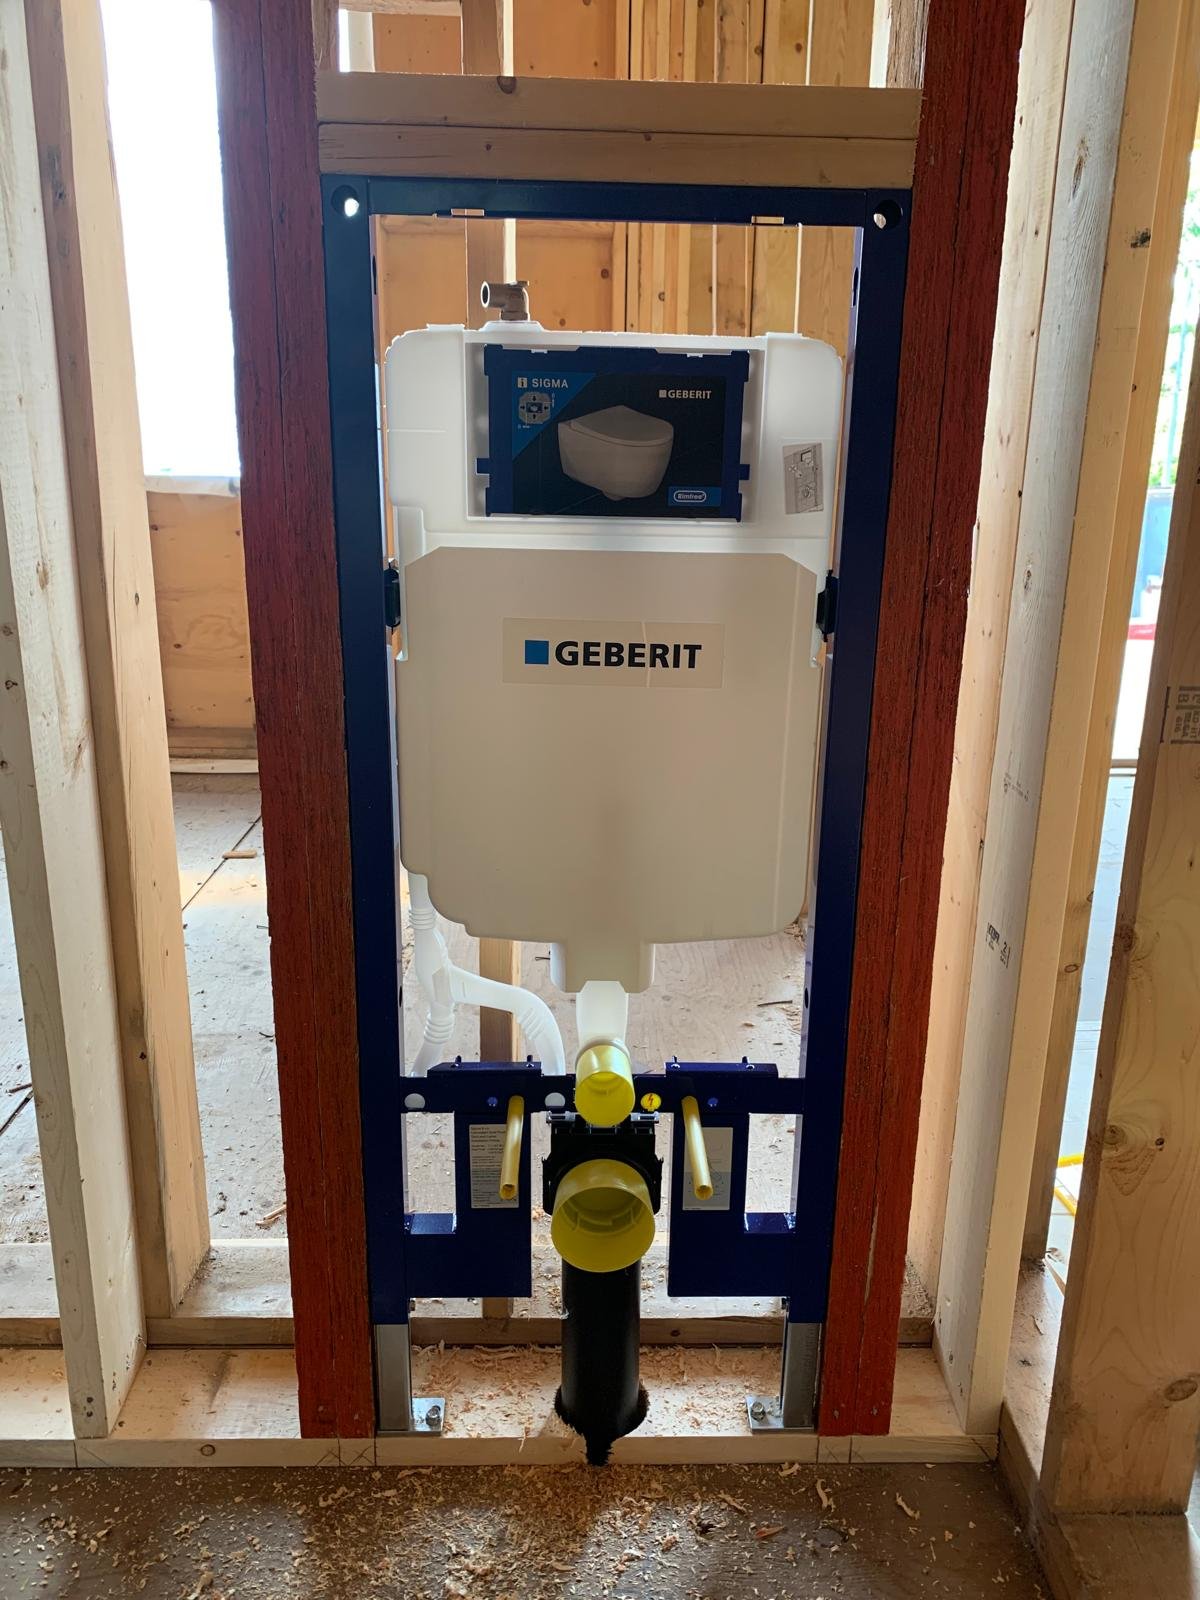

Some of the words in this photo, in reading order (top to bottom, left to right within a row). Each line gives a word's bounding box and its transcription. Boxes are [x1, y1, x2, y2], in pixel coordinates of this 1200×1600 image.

[531, 378, 568, 389] SIGMA
[668, 389, 712, 399] GEBERIT
[555, 640, 702, 669] GEBERIT
